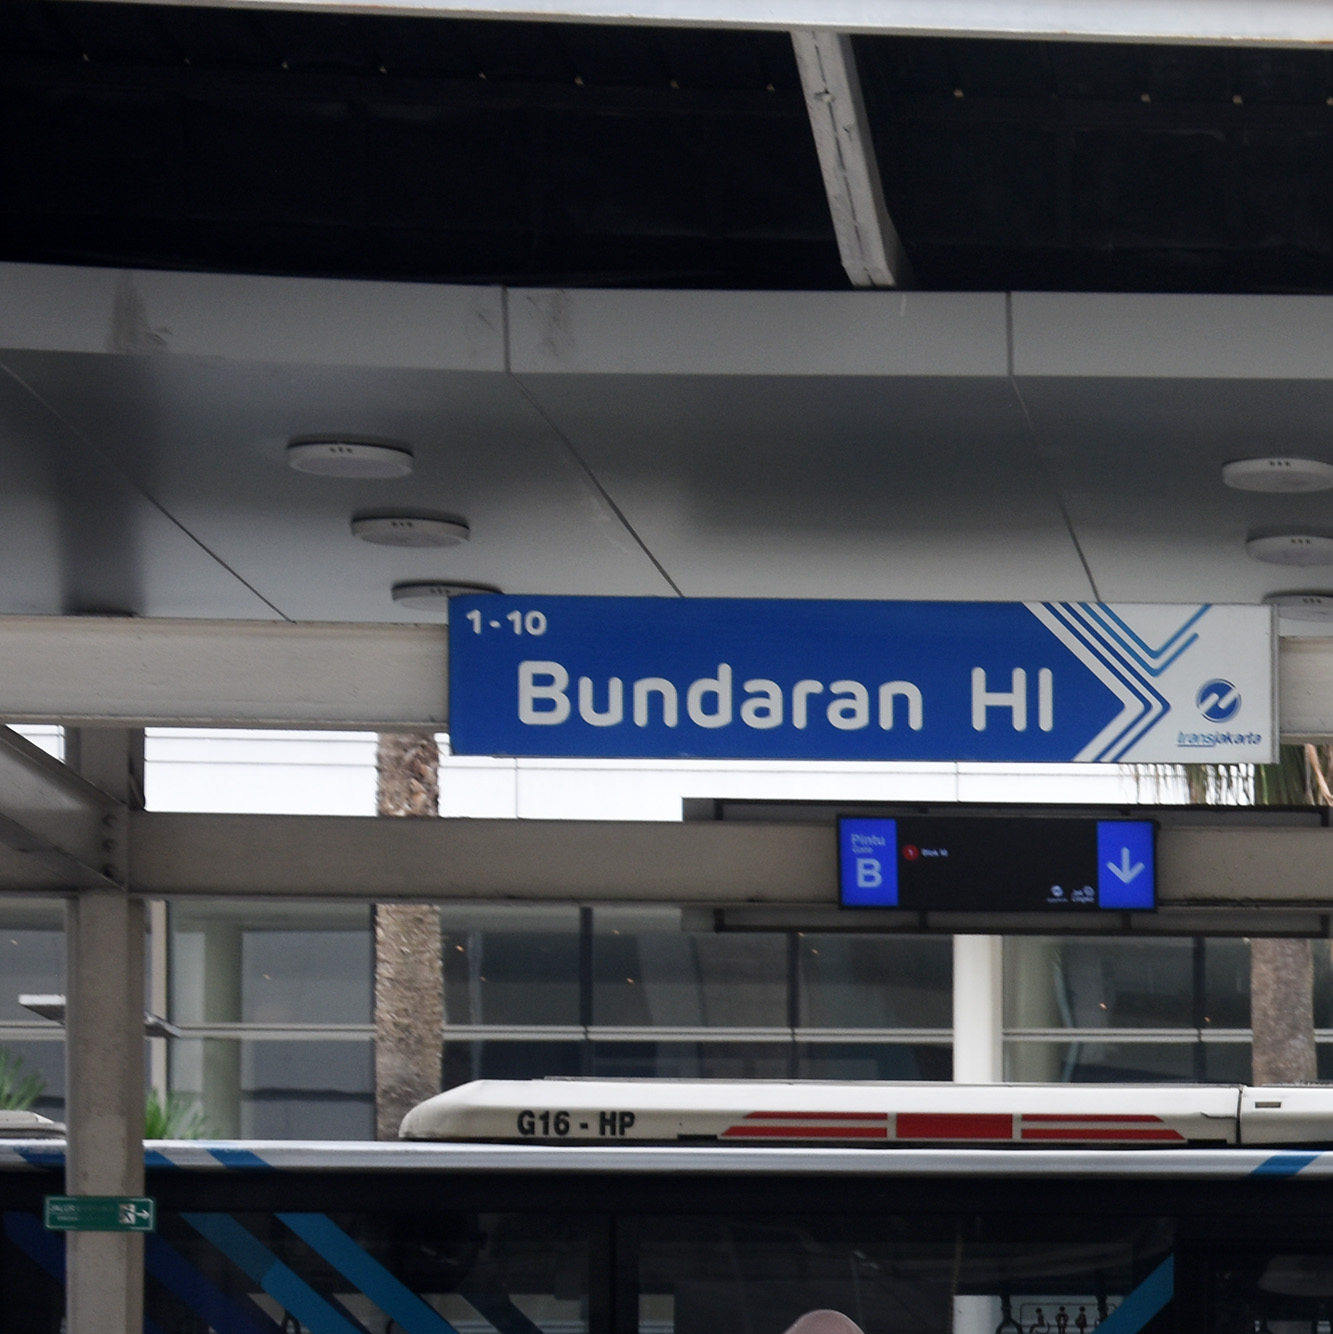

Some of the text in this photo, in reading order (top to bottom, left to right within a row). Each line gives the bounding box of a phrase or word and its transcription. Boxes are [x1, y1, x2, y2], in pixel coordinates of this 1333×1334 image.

[517, 659, 1054, 732] Bundaran HI
[1177, 730, 1262, 747] transjakarta
[851, 834, 886, 846] Pintu
[856, 858, 882, 888] B
[517, 1110, 570, 1136] G16
[599, 1111, 635, 1136] HP
